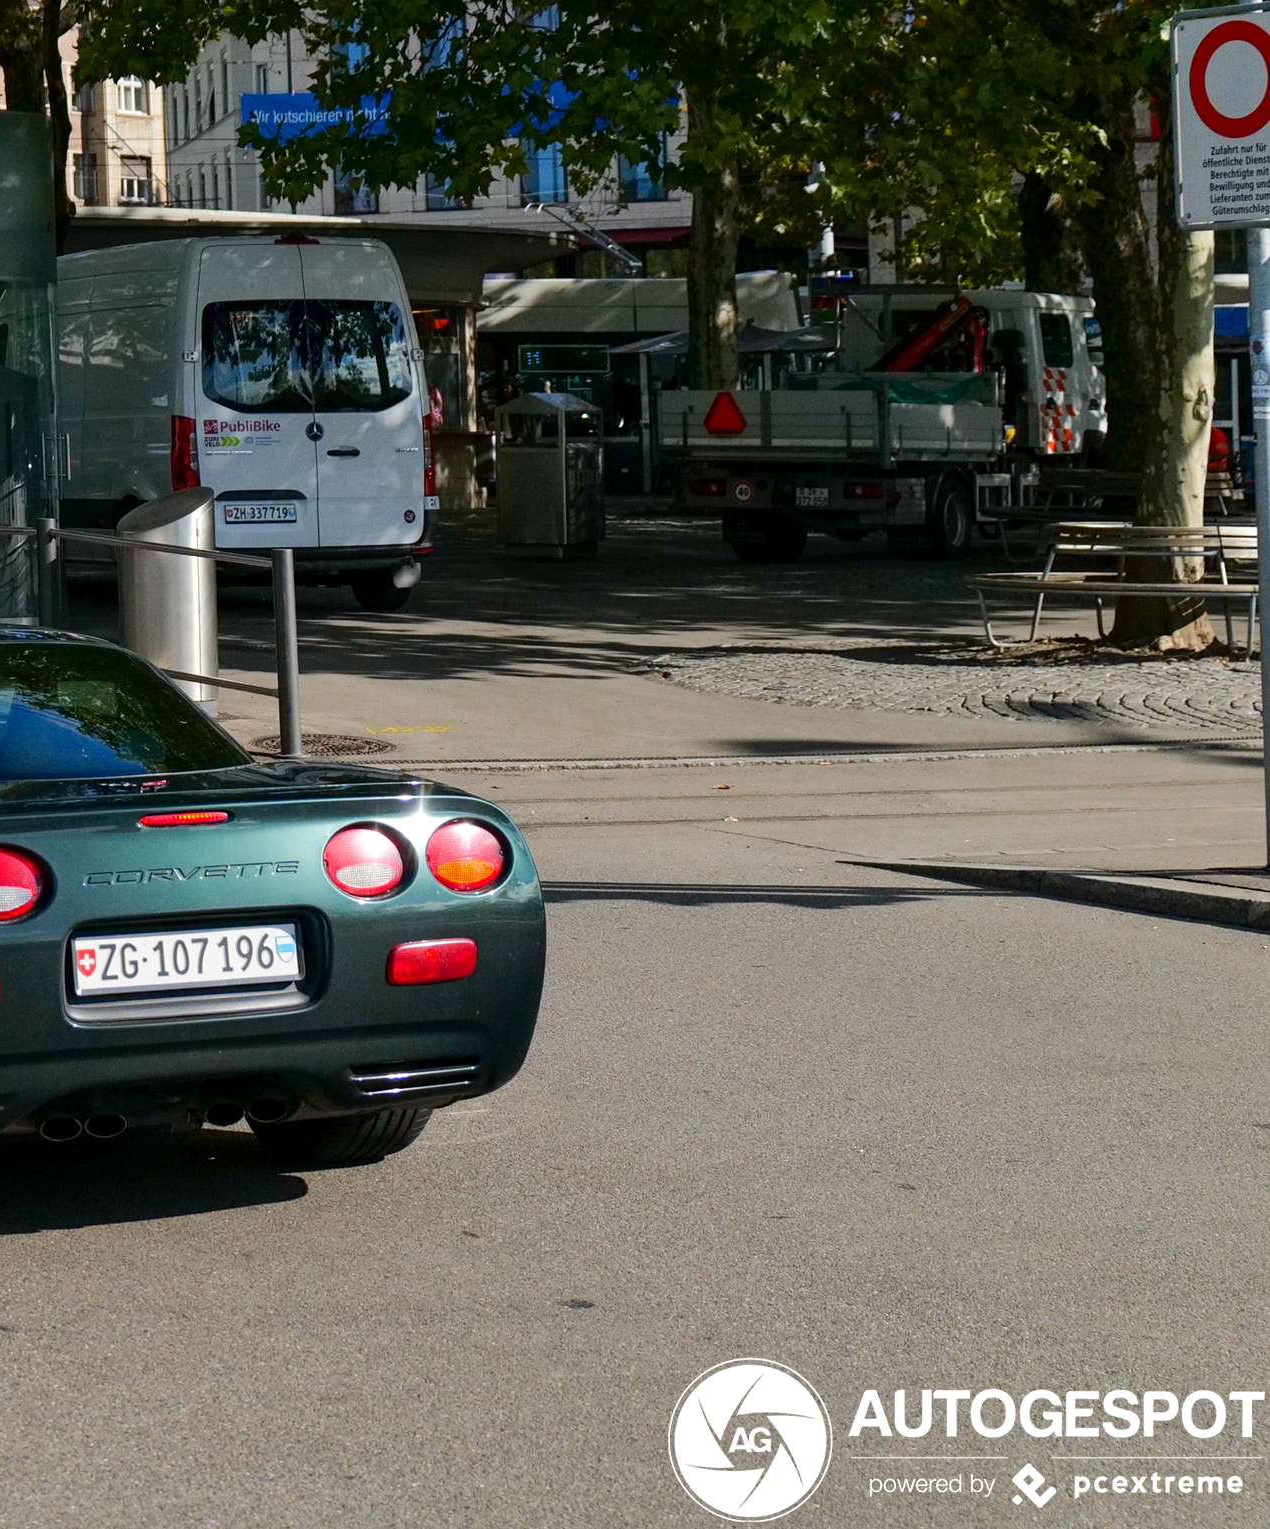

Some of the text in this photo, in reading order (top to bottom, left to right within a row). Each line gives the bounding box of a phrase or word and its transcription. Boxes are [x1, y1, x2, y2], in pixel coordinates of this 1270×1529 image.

[273, 109, 342, 124] kutschieren
[1210, 142, 1267, 156] Zufahrt nur für
[1202, 157, 1244, 168] öffentliche
[1210, 166, 1269, 180] Berechtigte mit
[1209, 179, 1270, 192] Bewilligung und
[1210, 192, 1270, 204] Lieferanten zum
[1212, 203, 1270, 215] Güterumschlag
[220, 419, 281, 433] PubliBike
[738, 488, 749, 497] 40
[83, 860, 300, 886] CORVETTE
